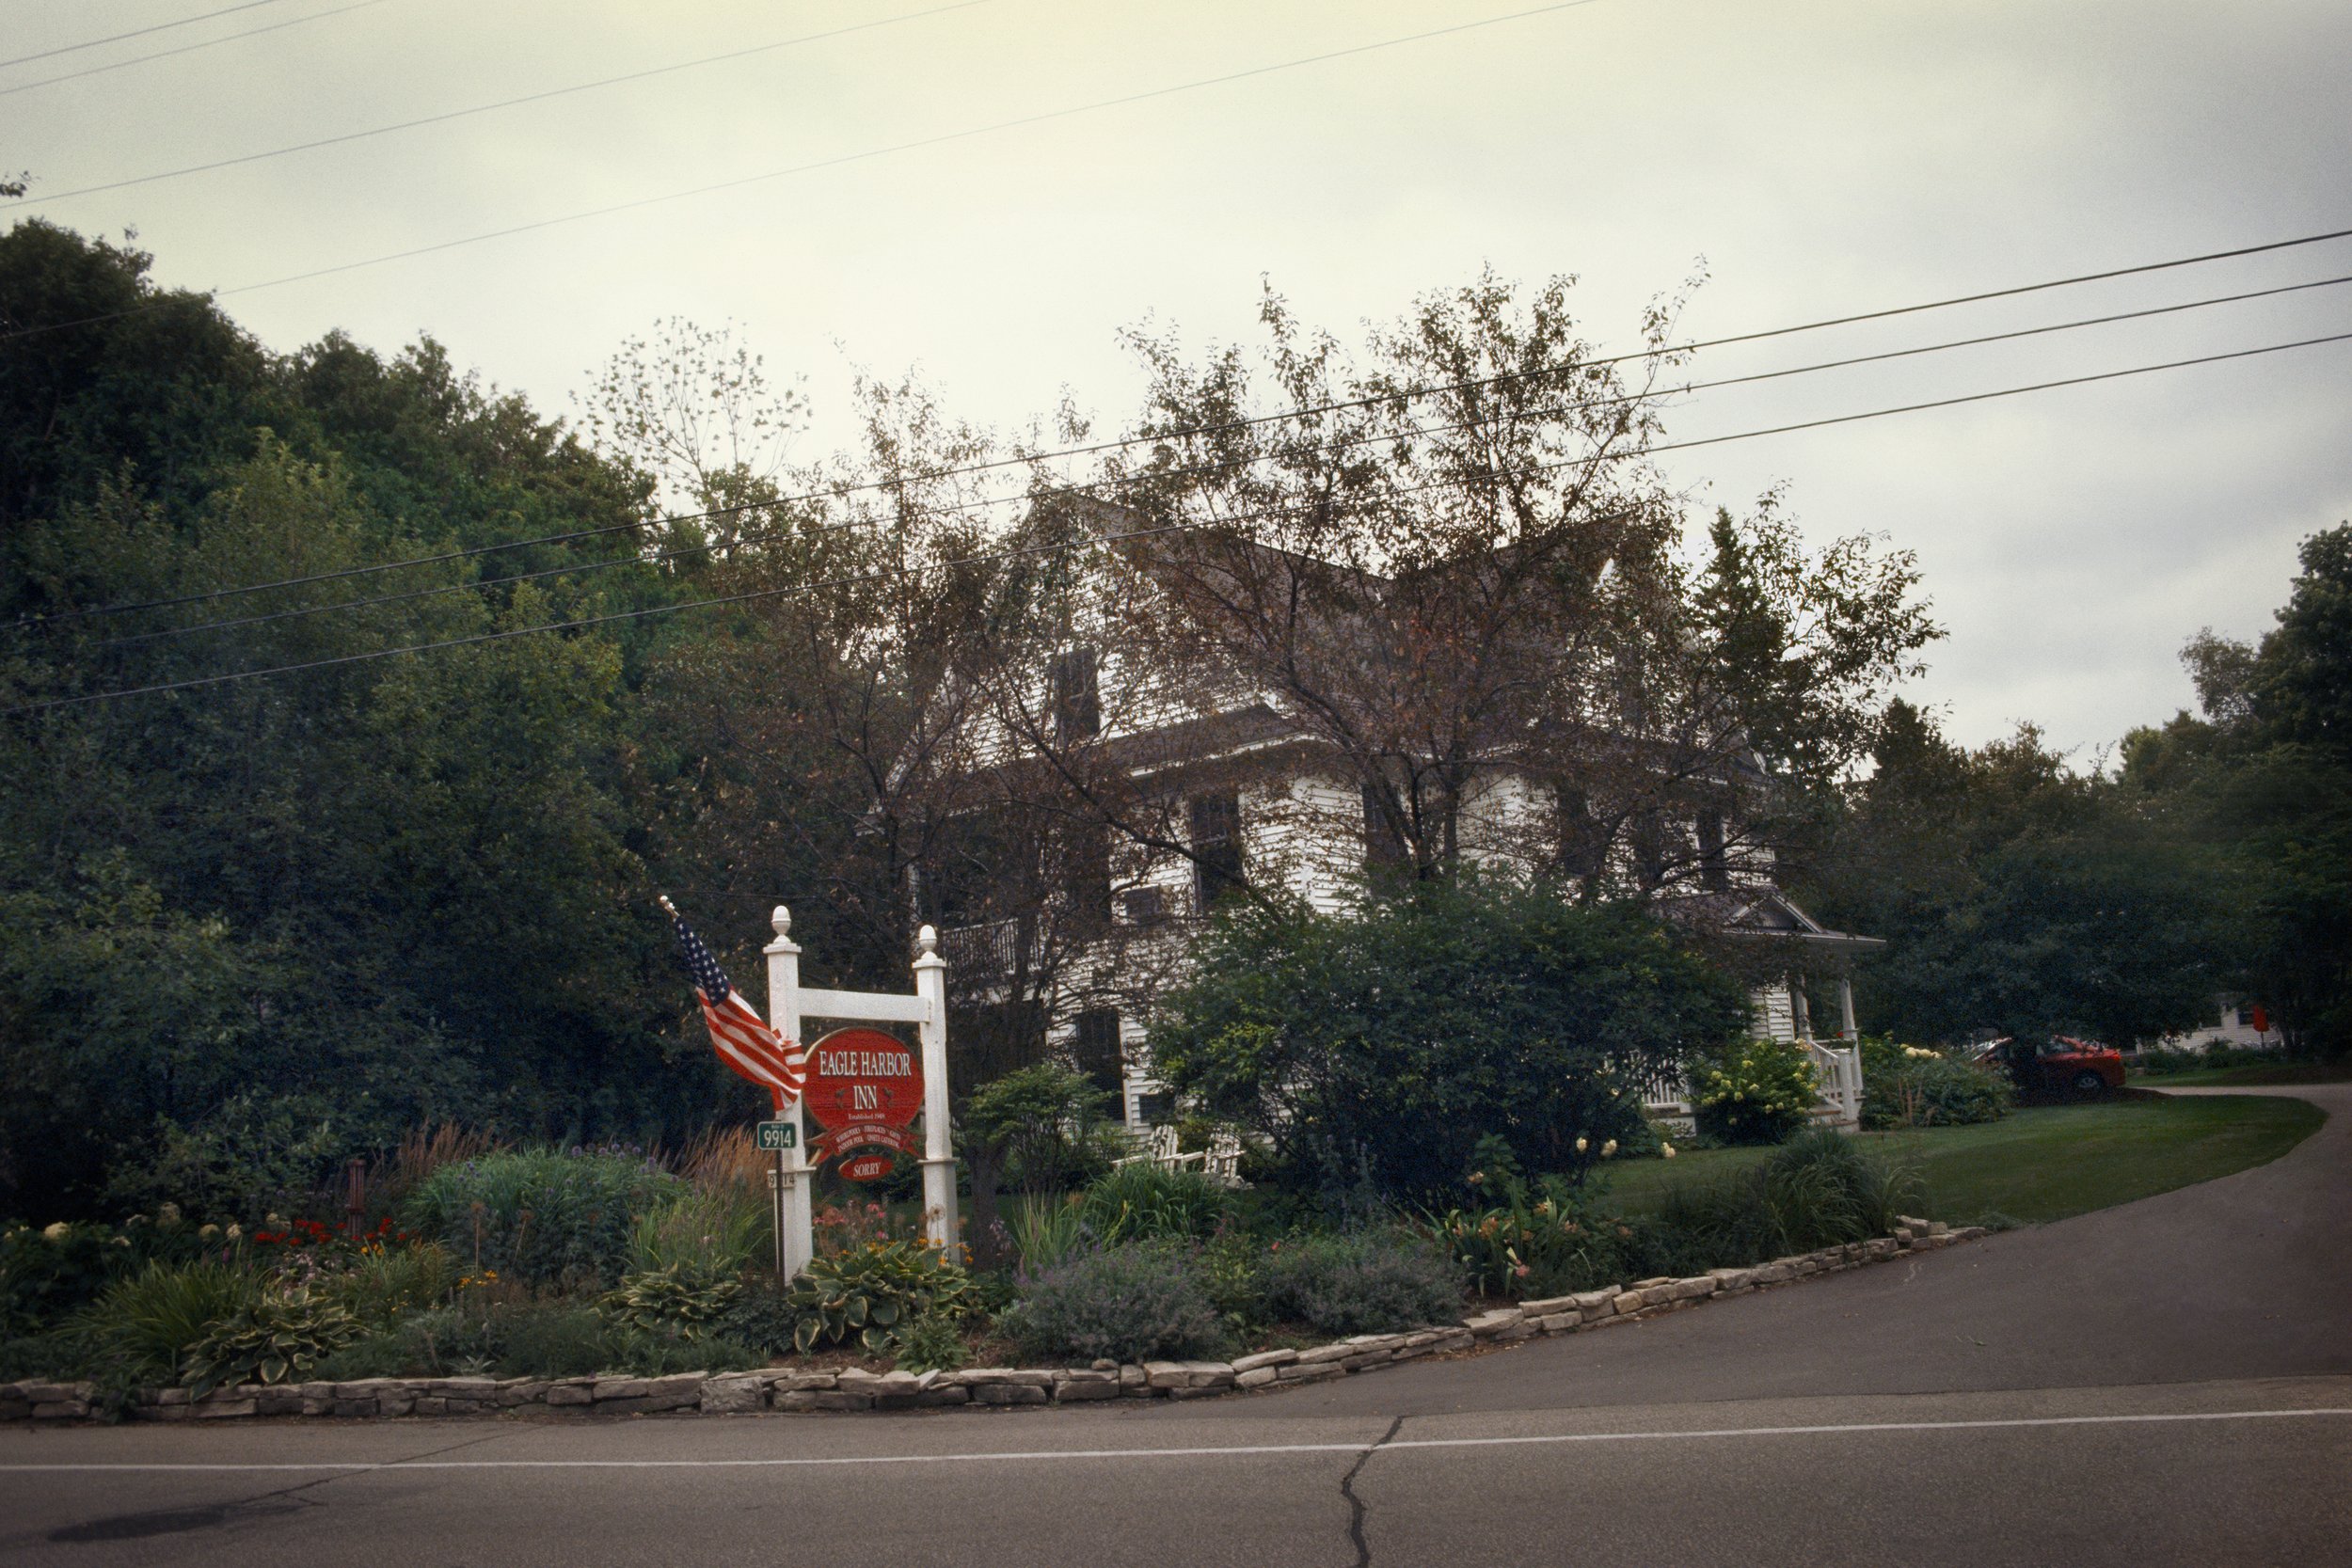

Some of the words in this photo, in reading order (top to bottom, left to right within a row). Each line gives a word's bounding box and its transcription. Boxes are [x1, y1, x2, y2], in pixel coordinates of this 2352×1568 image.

[818, 1051, 858, 1076] EAGLE
[861, 1052, 912, 1077] HARBOR
[853, 1085, 878, 1110] INN
[764, 1130, 791, 1147] 9914
[852, 1162, 882, 1178] SORRY
[769, 1174, 795, 1186] 914
